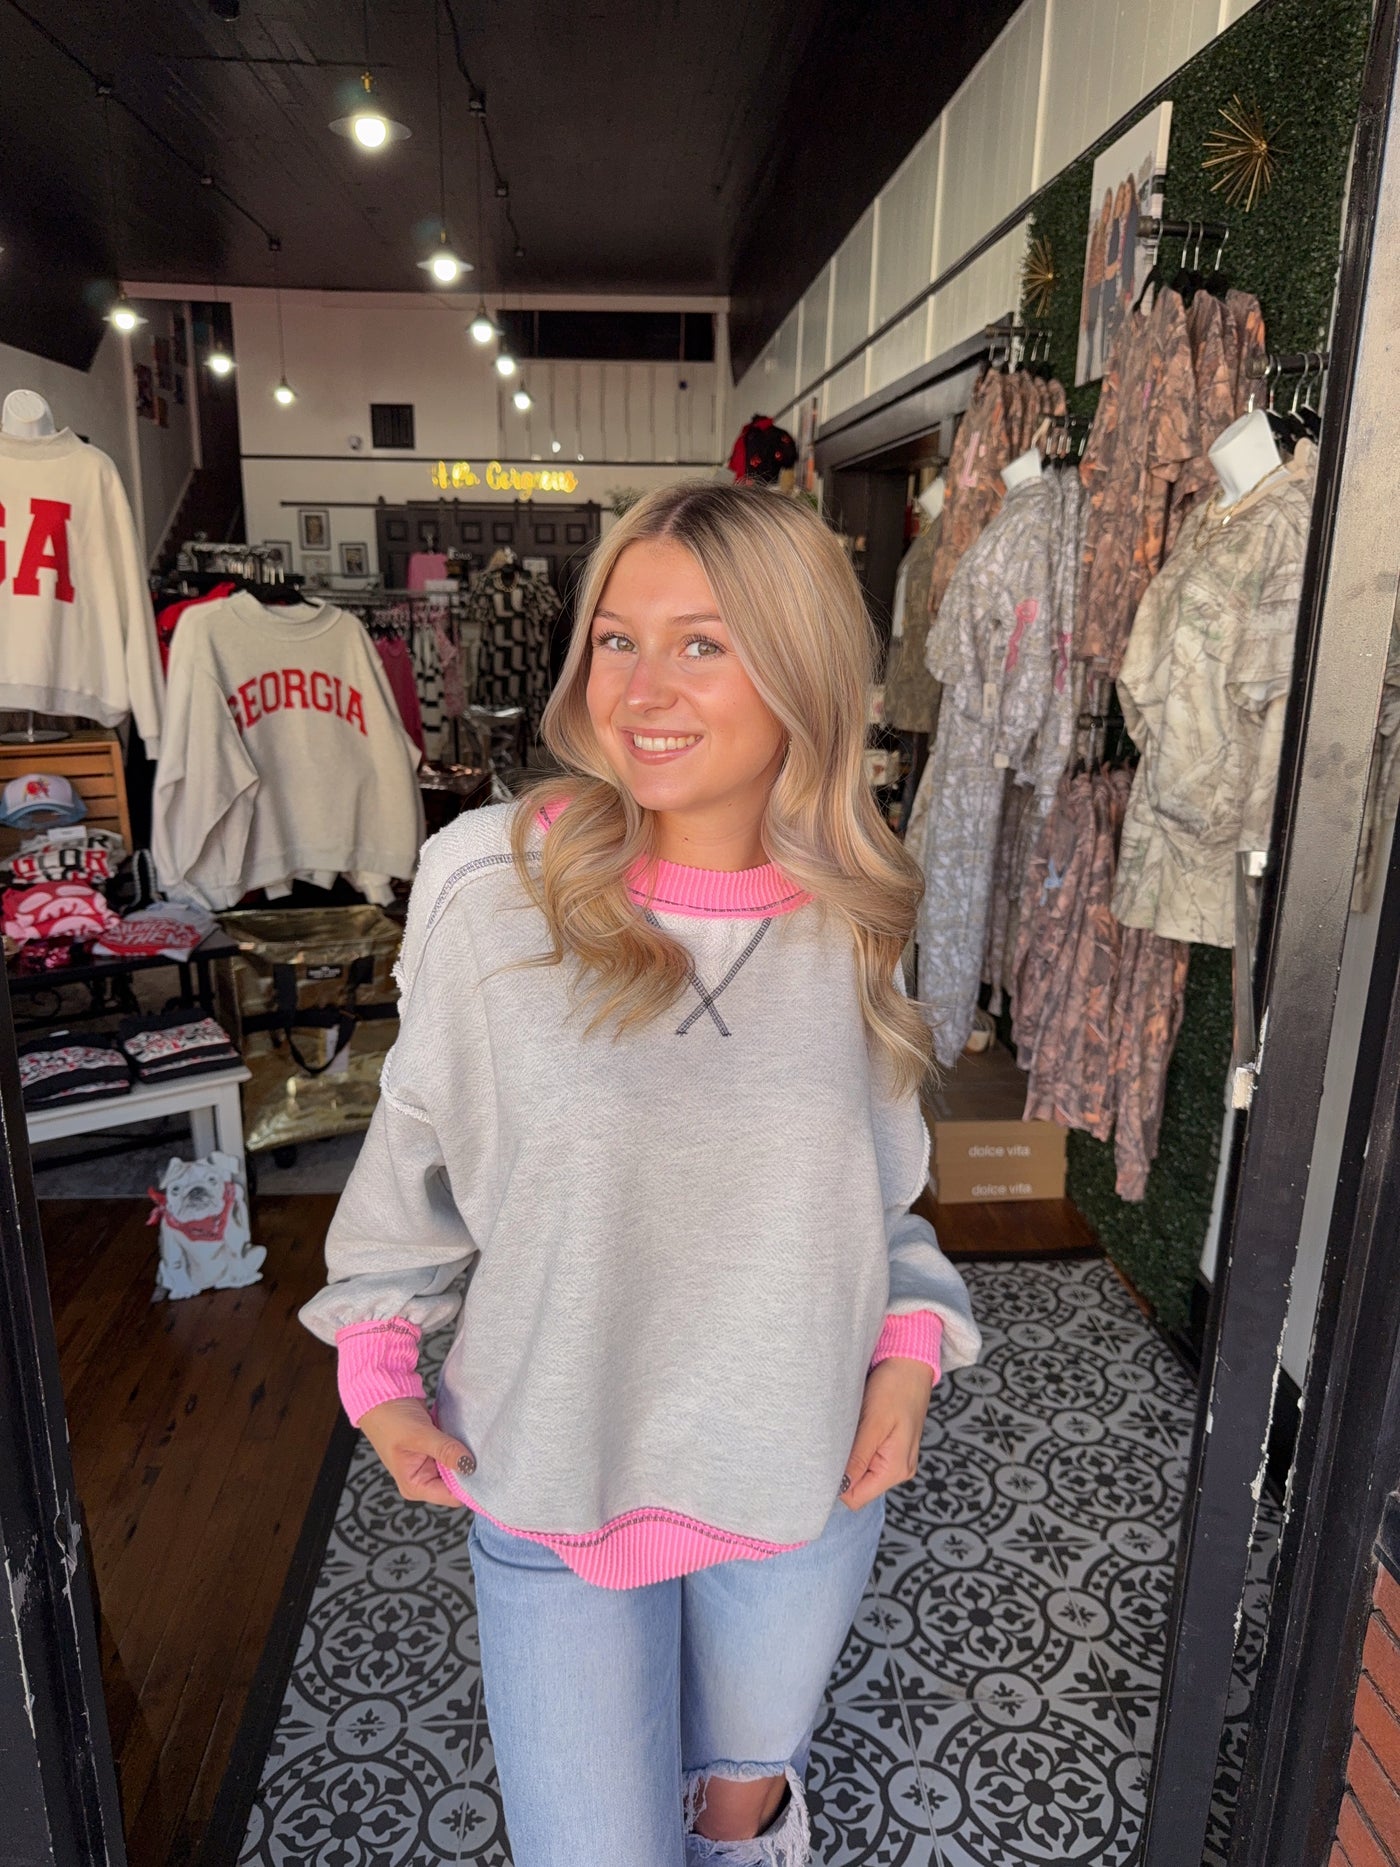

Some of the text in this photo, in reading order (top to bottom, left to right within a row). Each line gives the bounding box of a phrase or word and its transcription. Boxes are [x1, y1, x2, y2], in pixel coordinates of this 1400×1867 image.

[0, 497, 75, 604] A
[968, 1144, 1031, 1157] dolce vita
[971, 1183, 1032, 1196] dolce vita
